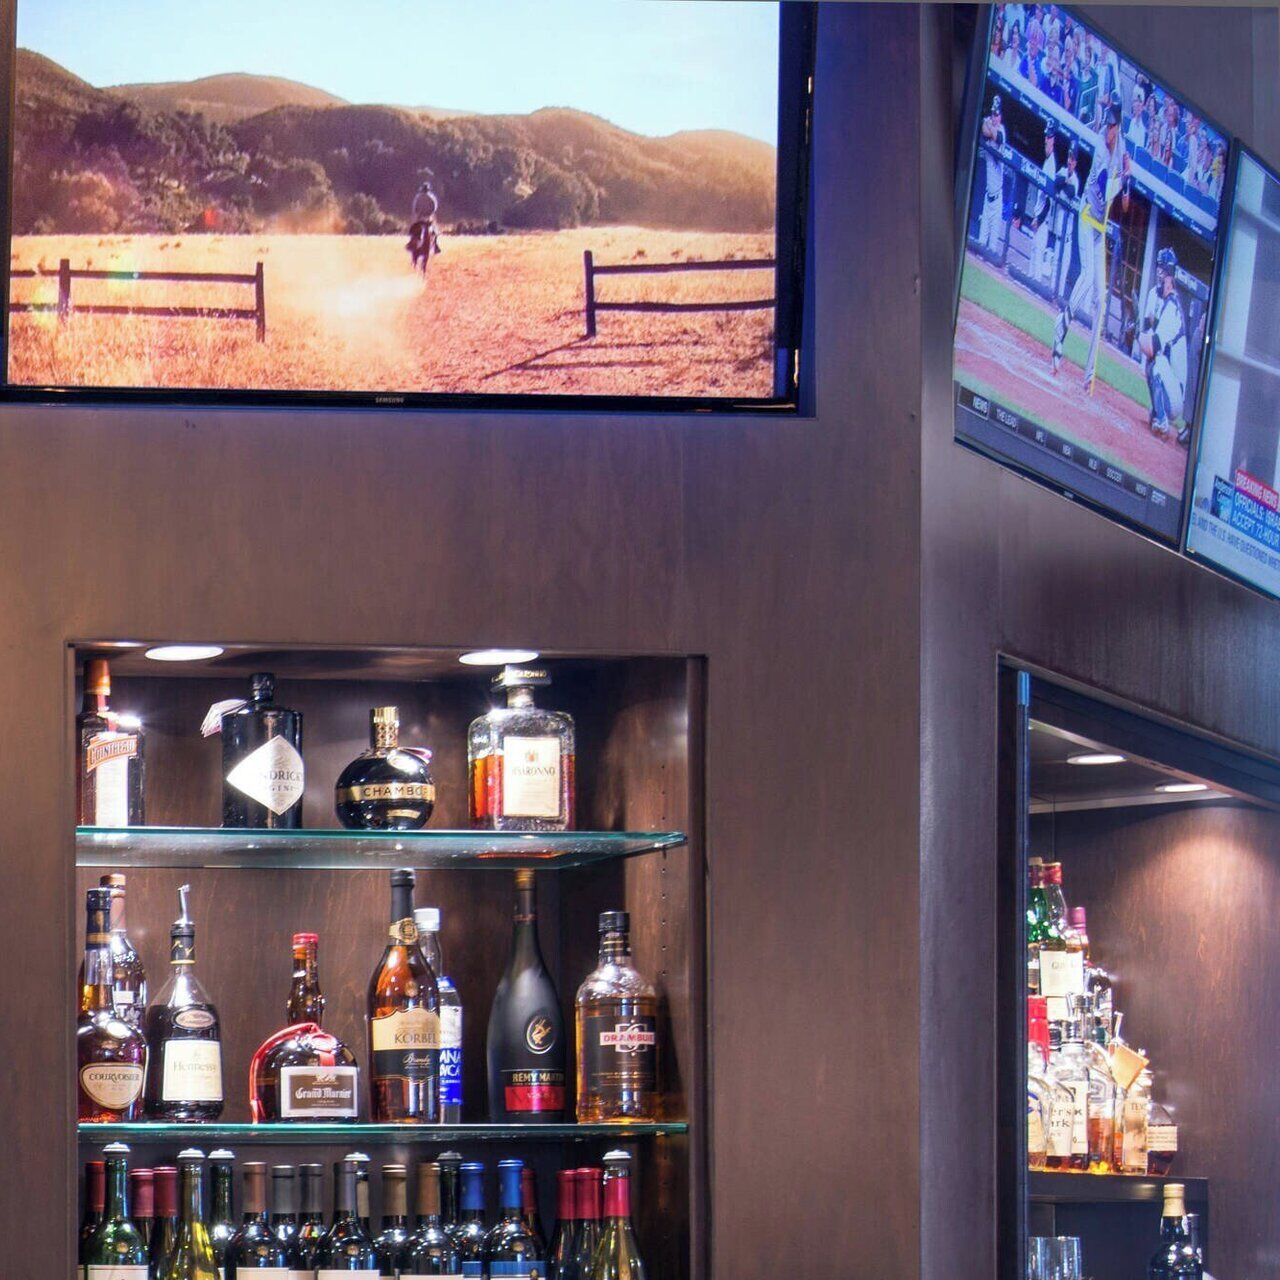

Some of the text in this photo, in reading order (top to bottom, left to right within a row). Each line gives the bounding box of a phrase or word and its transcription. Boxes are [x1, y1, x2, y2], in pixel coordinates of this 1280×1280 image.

[1236, 471, 1262, 500] BREAKING
[1262, 486, 1278, 508] NEWS
[394, 1033, 438, 1044] KORBEL
[603, 1034, 654, 1042] DRAMBUIE
[173, 1061, 217, 1073] Hennessy
[295, 1087, 322, 1099] Grand
